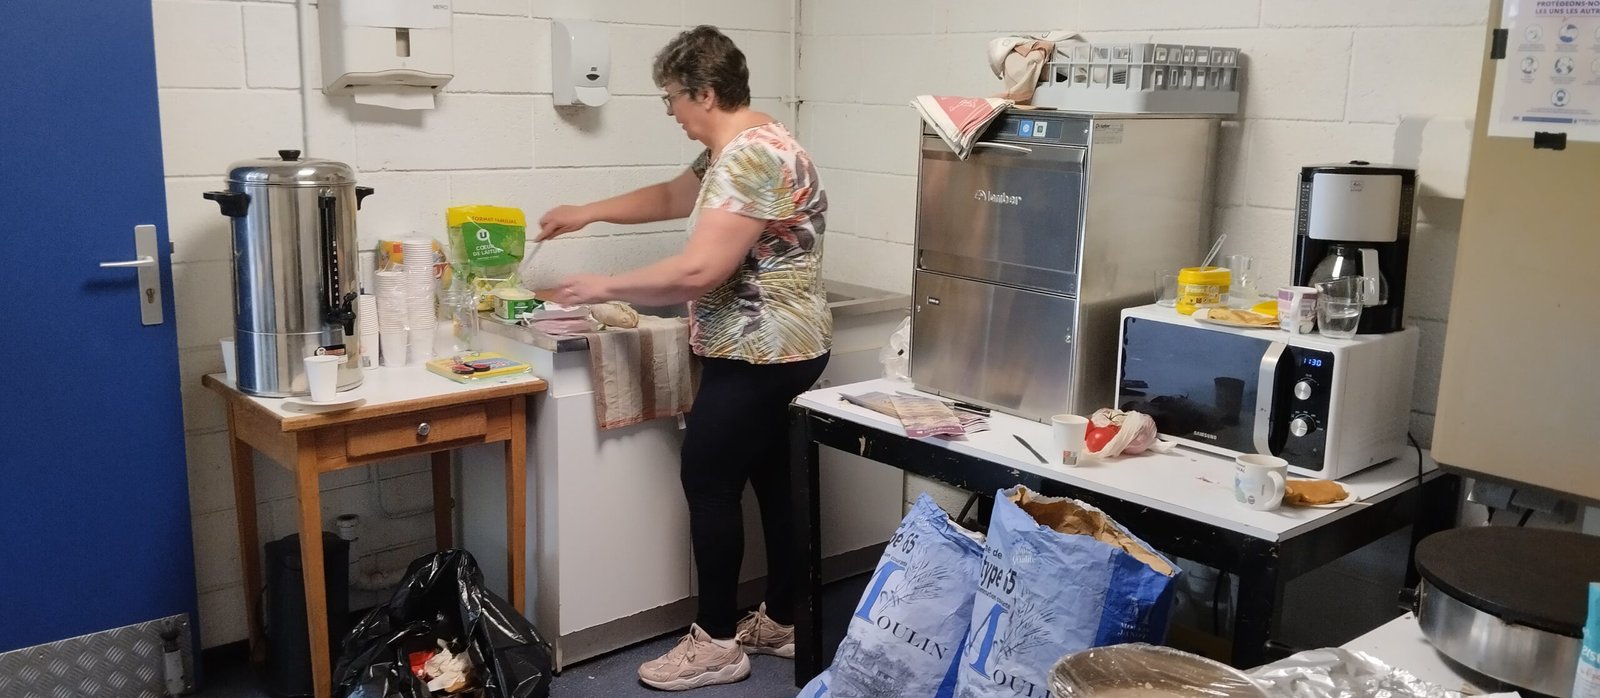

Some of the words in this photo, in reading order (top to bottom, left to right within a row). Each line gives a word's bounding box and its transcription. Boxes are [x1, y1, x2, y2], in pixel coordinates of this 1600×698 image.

[1193, 430, 1217, 440] SAMSUNG
[902, 533, 919, 554] 65
[993, 549, 1003, 559] de
[981, 555, 1003, 589] type
